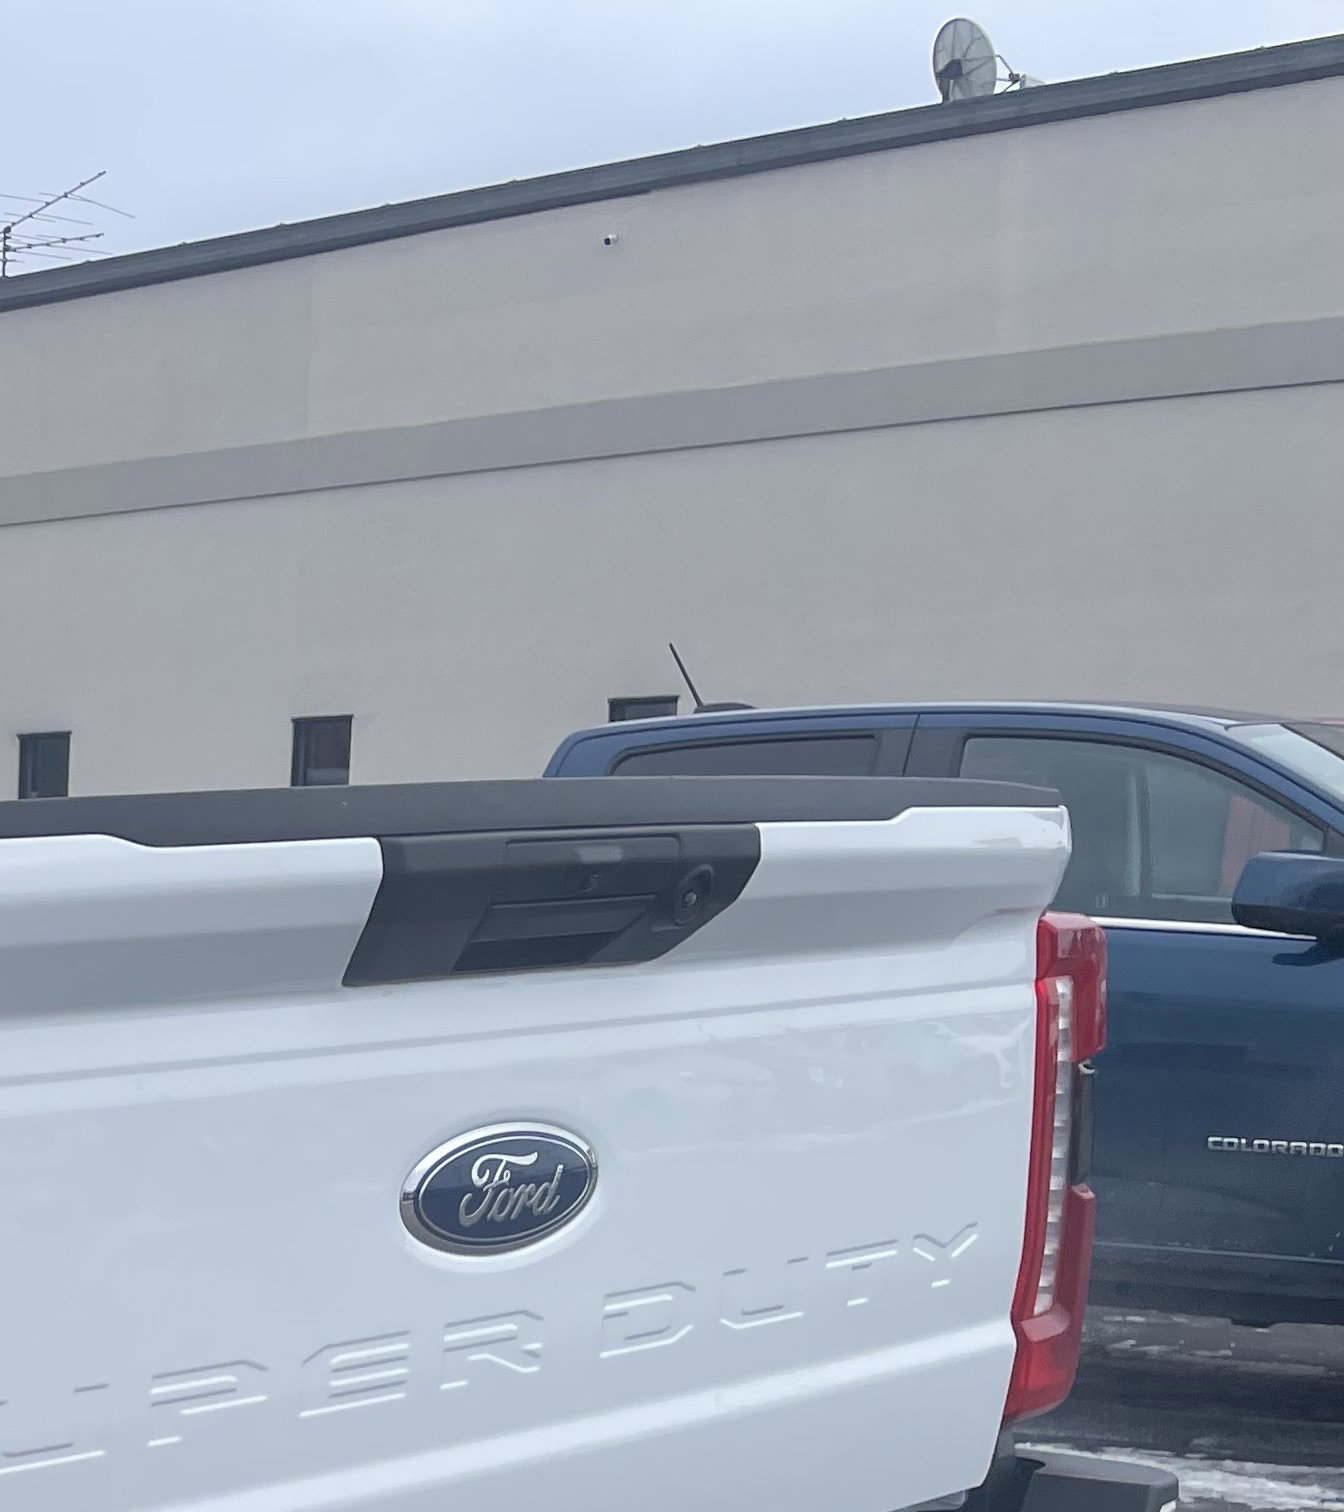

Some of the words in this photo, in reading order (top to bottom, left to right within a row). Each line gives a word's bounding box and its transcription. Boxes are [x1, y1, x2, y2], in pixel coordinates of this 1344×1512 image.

[1207, 1136, 1344, 1157] COLORADO
[458, 1151, 564, 1227] Ford
[599, 1221, 979, 1359] DUTY
